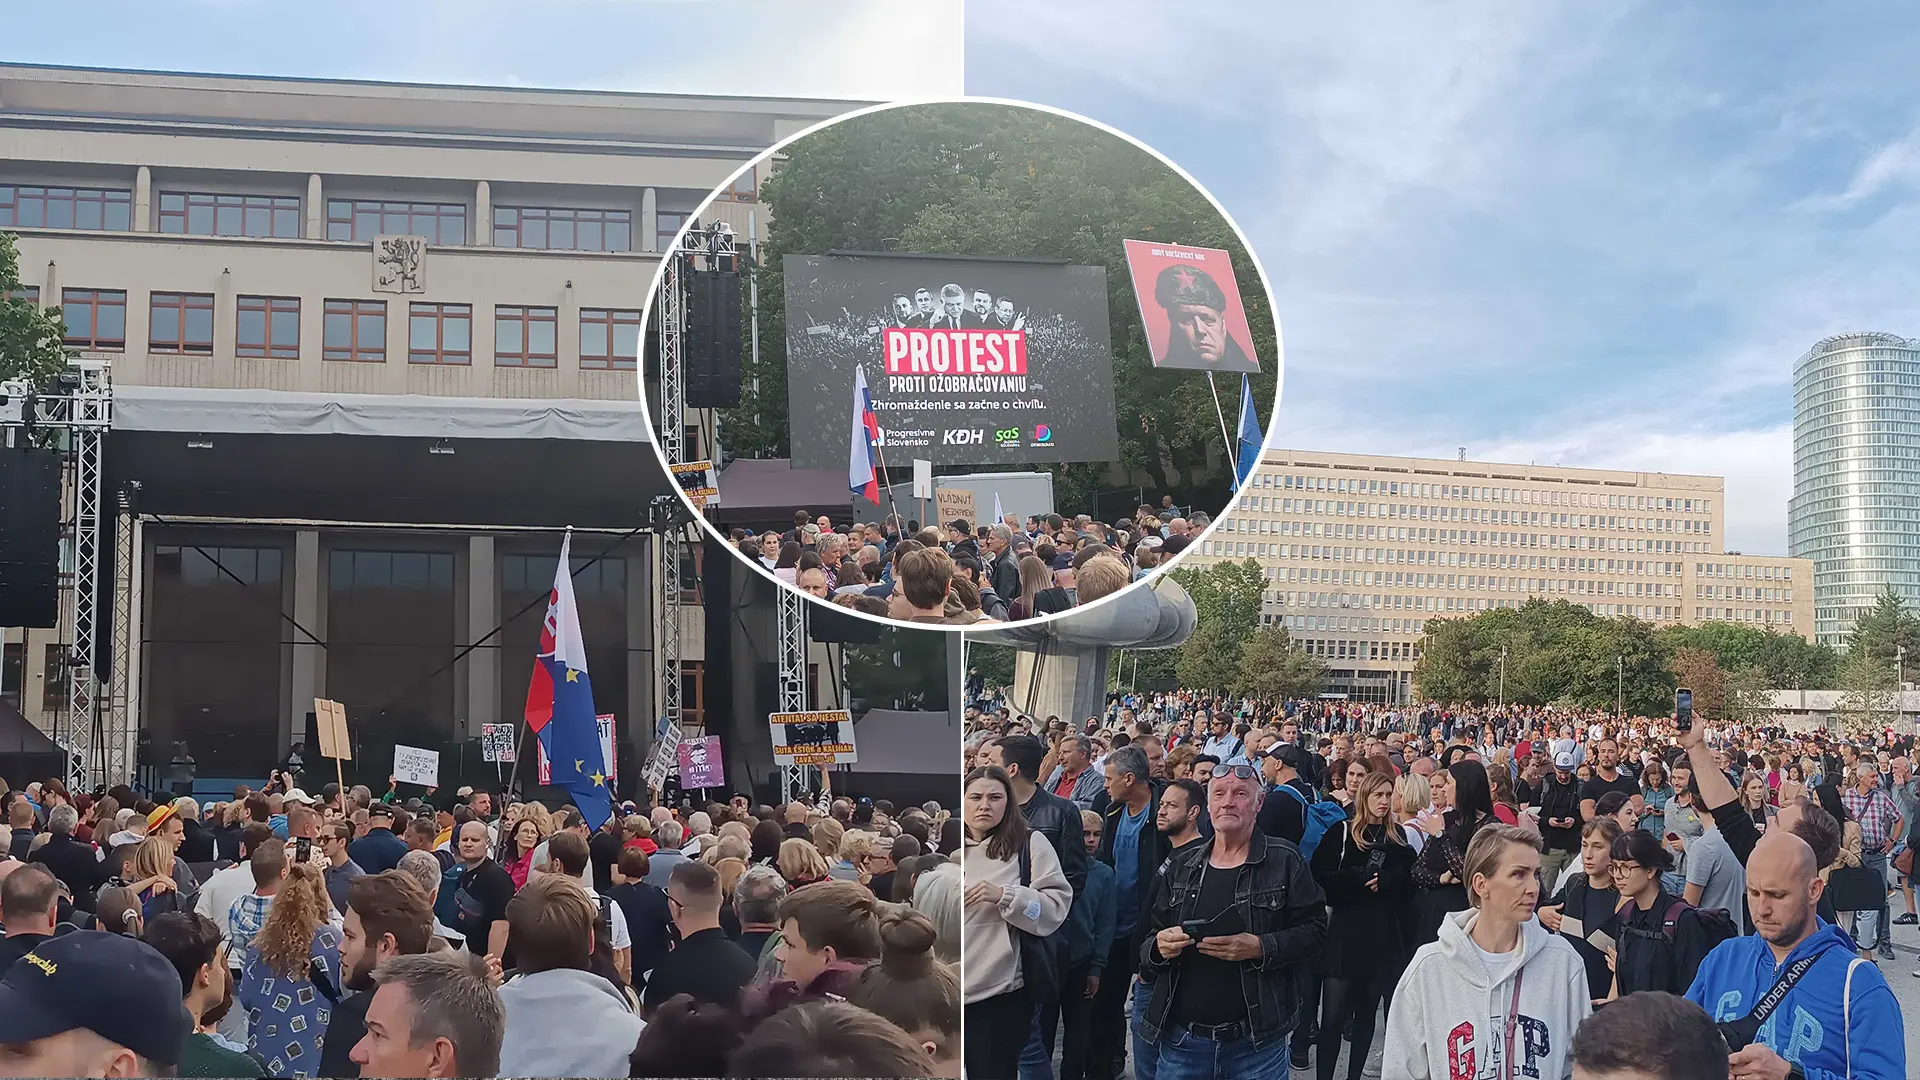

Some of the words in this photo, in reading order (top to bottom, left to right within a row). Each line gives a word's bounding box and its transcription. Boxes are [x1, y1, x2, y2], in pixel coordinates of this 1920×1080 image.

[888, 331, 1021, 373] PROTEST
[889, 376, 925, 393] PROTI
[929, 373, 1027, 393] OŽOBRAČOVANIU
[871, 399, 951, 411] Zhromaždenie
[954, 401, 966, 410] sa
[968, 400, 1000, 410] začne
[1002, 402, 1010, 410] o
[886, 428, 936, 438] Progresívne
[886, 438, 929, 447] Slovensko
[806, 712, 819, 722] SA
[1753, 980, 1789, 1021] UNDER
[1786, 956, 1816, 983] ARM
[1447, 1014, 1551, 1080] GAP
